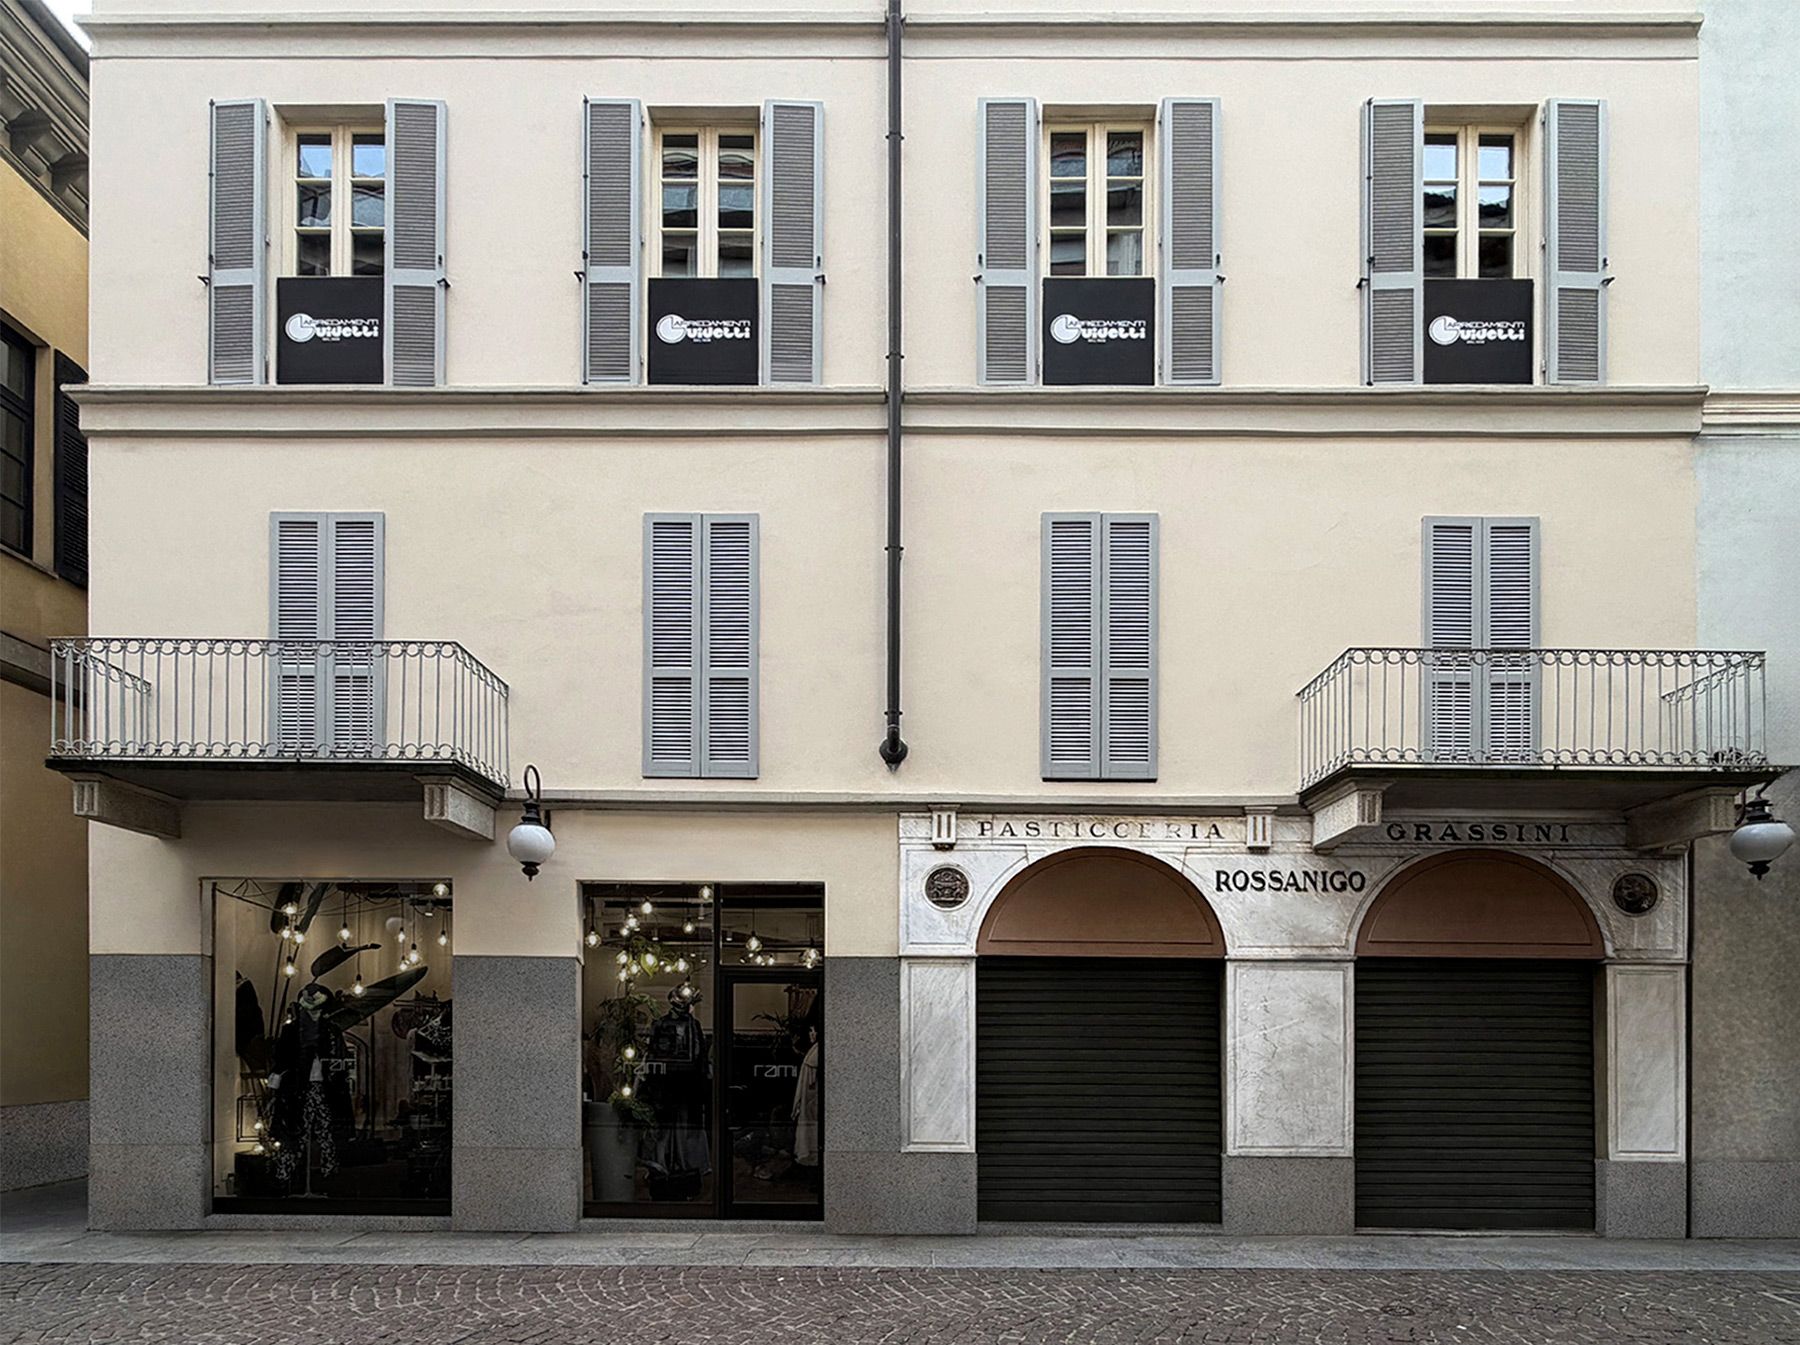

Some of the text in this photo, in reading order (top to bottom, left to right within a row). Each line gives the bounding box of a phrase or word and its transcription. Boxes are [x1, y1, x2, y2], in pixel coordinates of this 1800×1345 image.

[977, 820, 1225, 839] PASTICCERIA
[1386, 823, 1570, 842] GRASSINI
[1215, 870, 1366, 893] ROSSANIGO
[754, 1064, 798, 1078] rami
